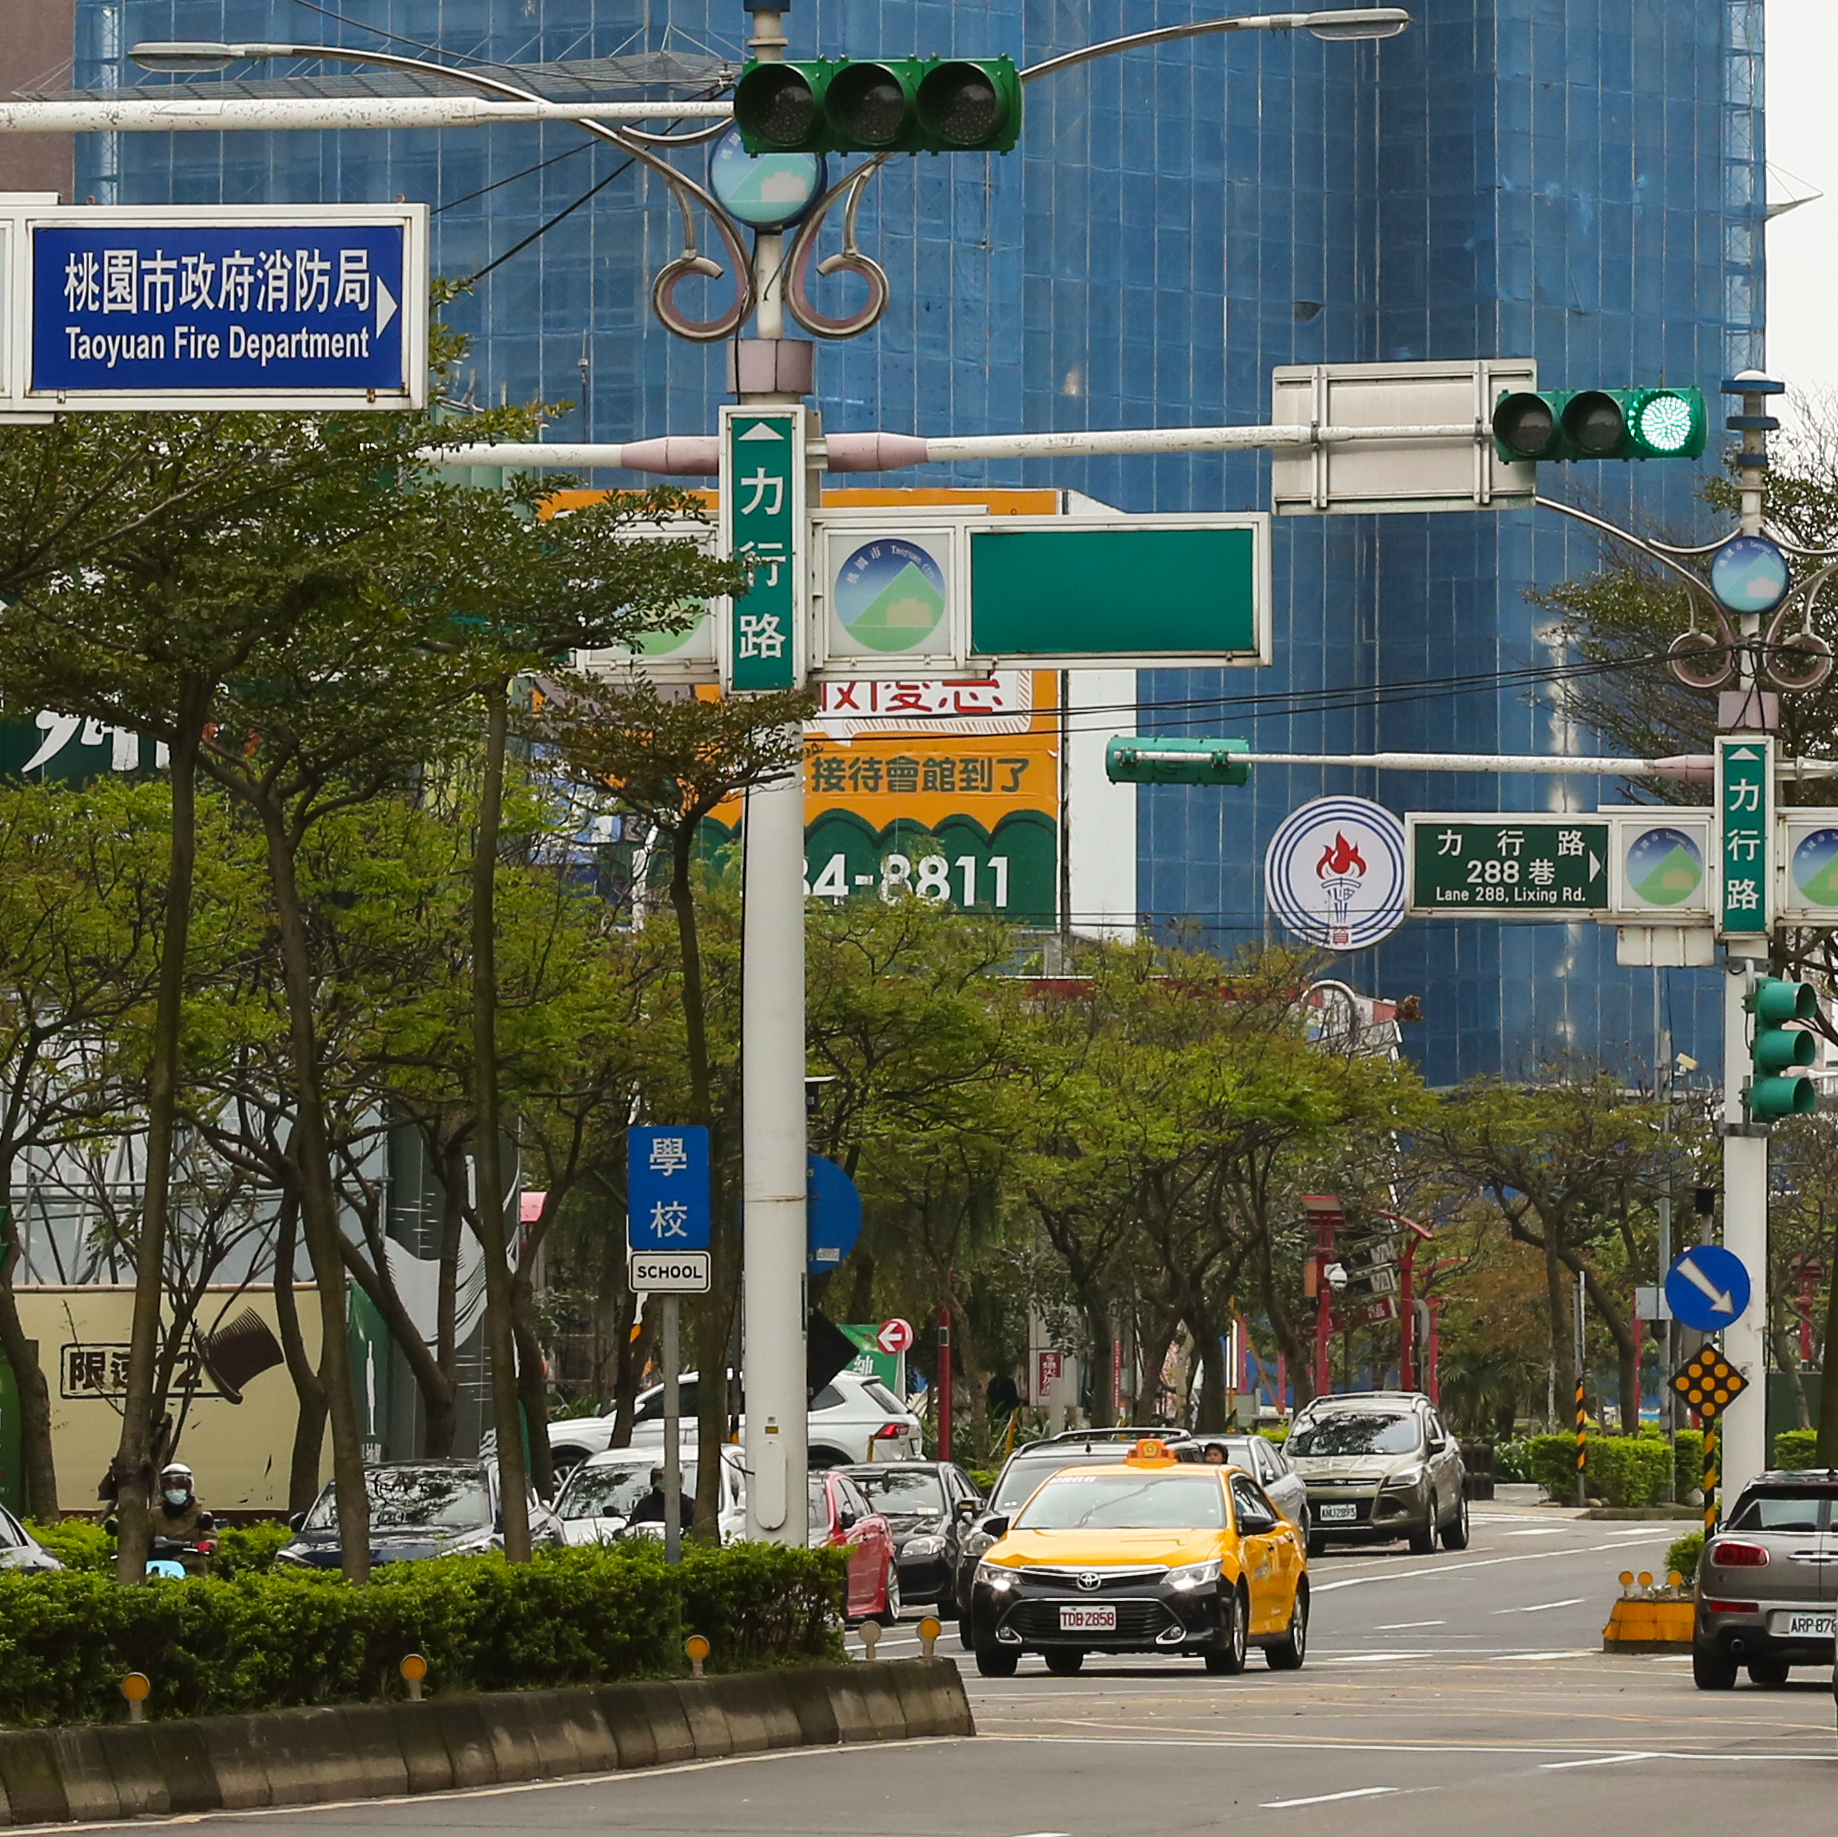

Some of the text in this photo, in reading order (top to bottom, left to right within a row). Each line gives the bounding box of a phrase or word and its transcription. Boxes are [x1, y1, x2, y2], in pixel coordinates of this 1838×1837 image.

[64, 248, 370, 315] 桃園市政府消防局
[65, 325, 370, 368] Taoyuan Fire Department
[738, 467, 787, 659] 力行路
[811, 756, 1030, 793] 接待會館到了
[1437, 829, 1585, 857] 力行路
[1727, 778, 1761, 911] 力行路
[803, 853, 1009, 909] 4-8811
[1436, 886, 1586, 903] Lane 288, Lixing Rd.
[649, 1137, 688, 1239] 學校
[637, 1265, 703, 1279] SCHOOL
